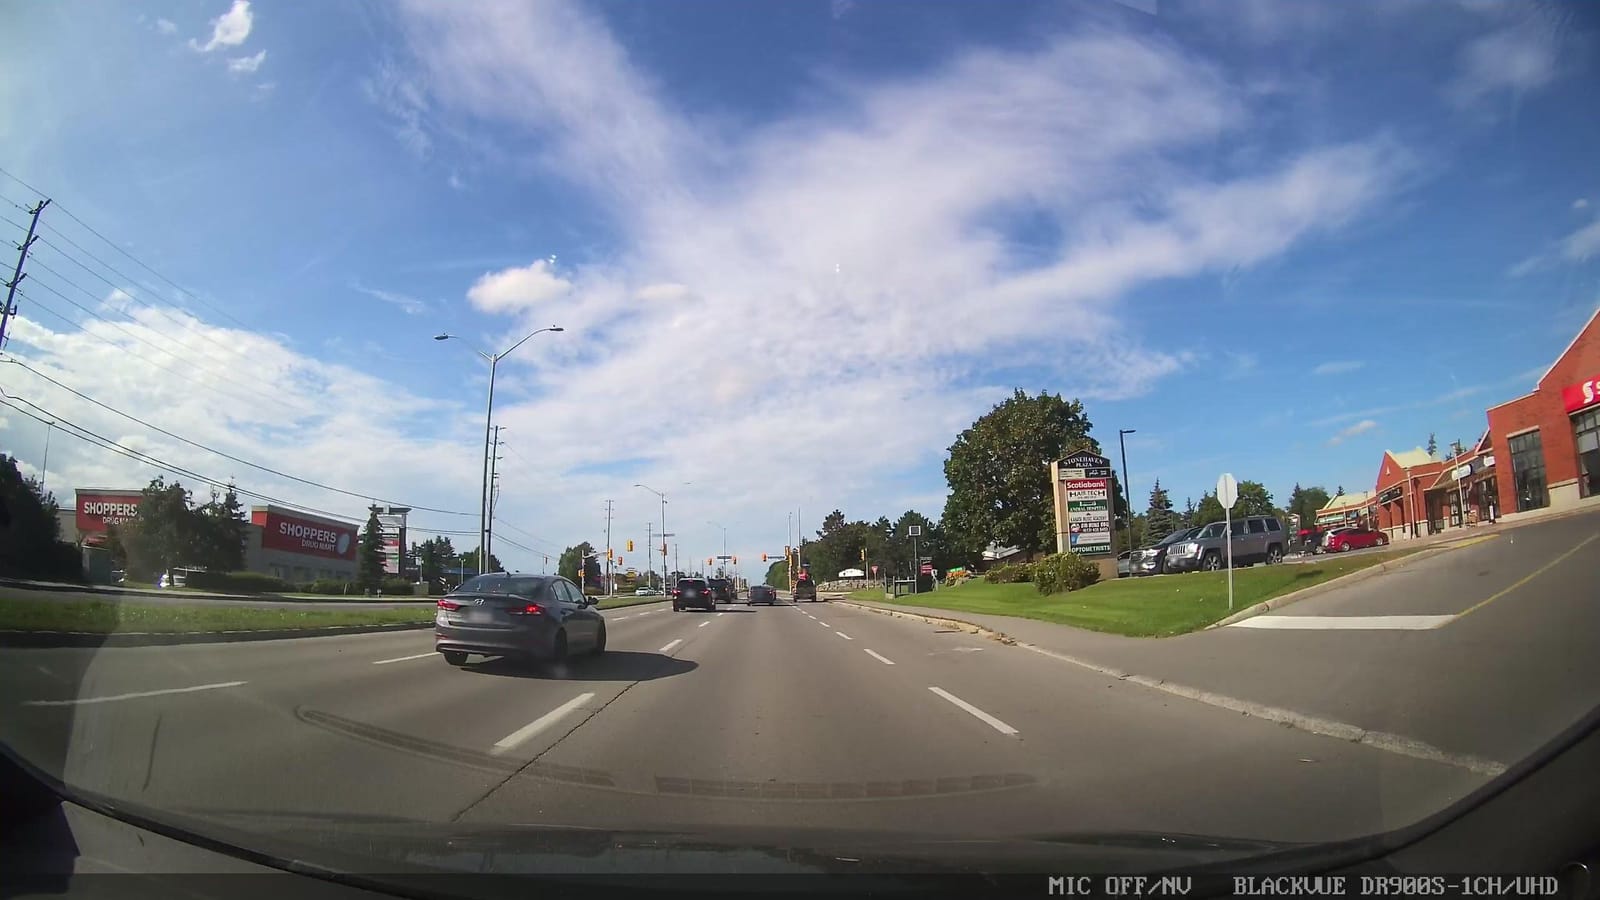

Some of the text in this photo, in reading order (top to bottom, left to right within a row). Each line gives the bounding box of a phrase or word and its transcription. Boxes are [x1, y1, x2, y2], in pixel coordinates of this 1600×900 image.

[1063, 456, 1104, 465] STONEHAVEN
[1066, 481, 1105, 489] Scotiabank
[84, 502, 138, 517] SHOPPERS
[102, 517, 119, 525] DRUG
[279, 522, 337, 543] SHOPPERS
[301, 538, 336, 551] DRUG MART
[1071, 545, 1110, 553] OPTOMETRISTS
